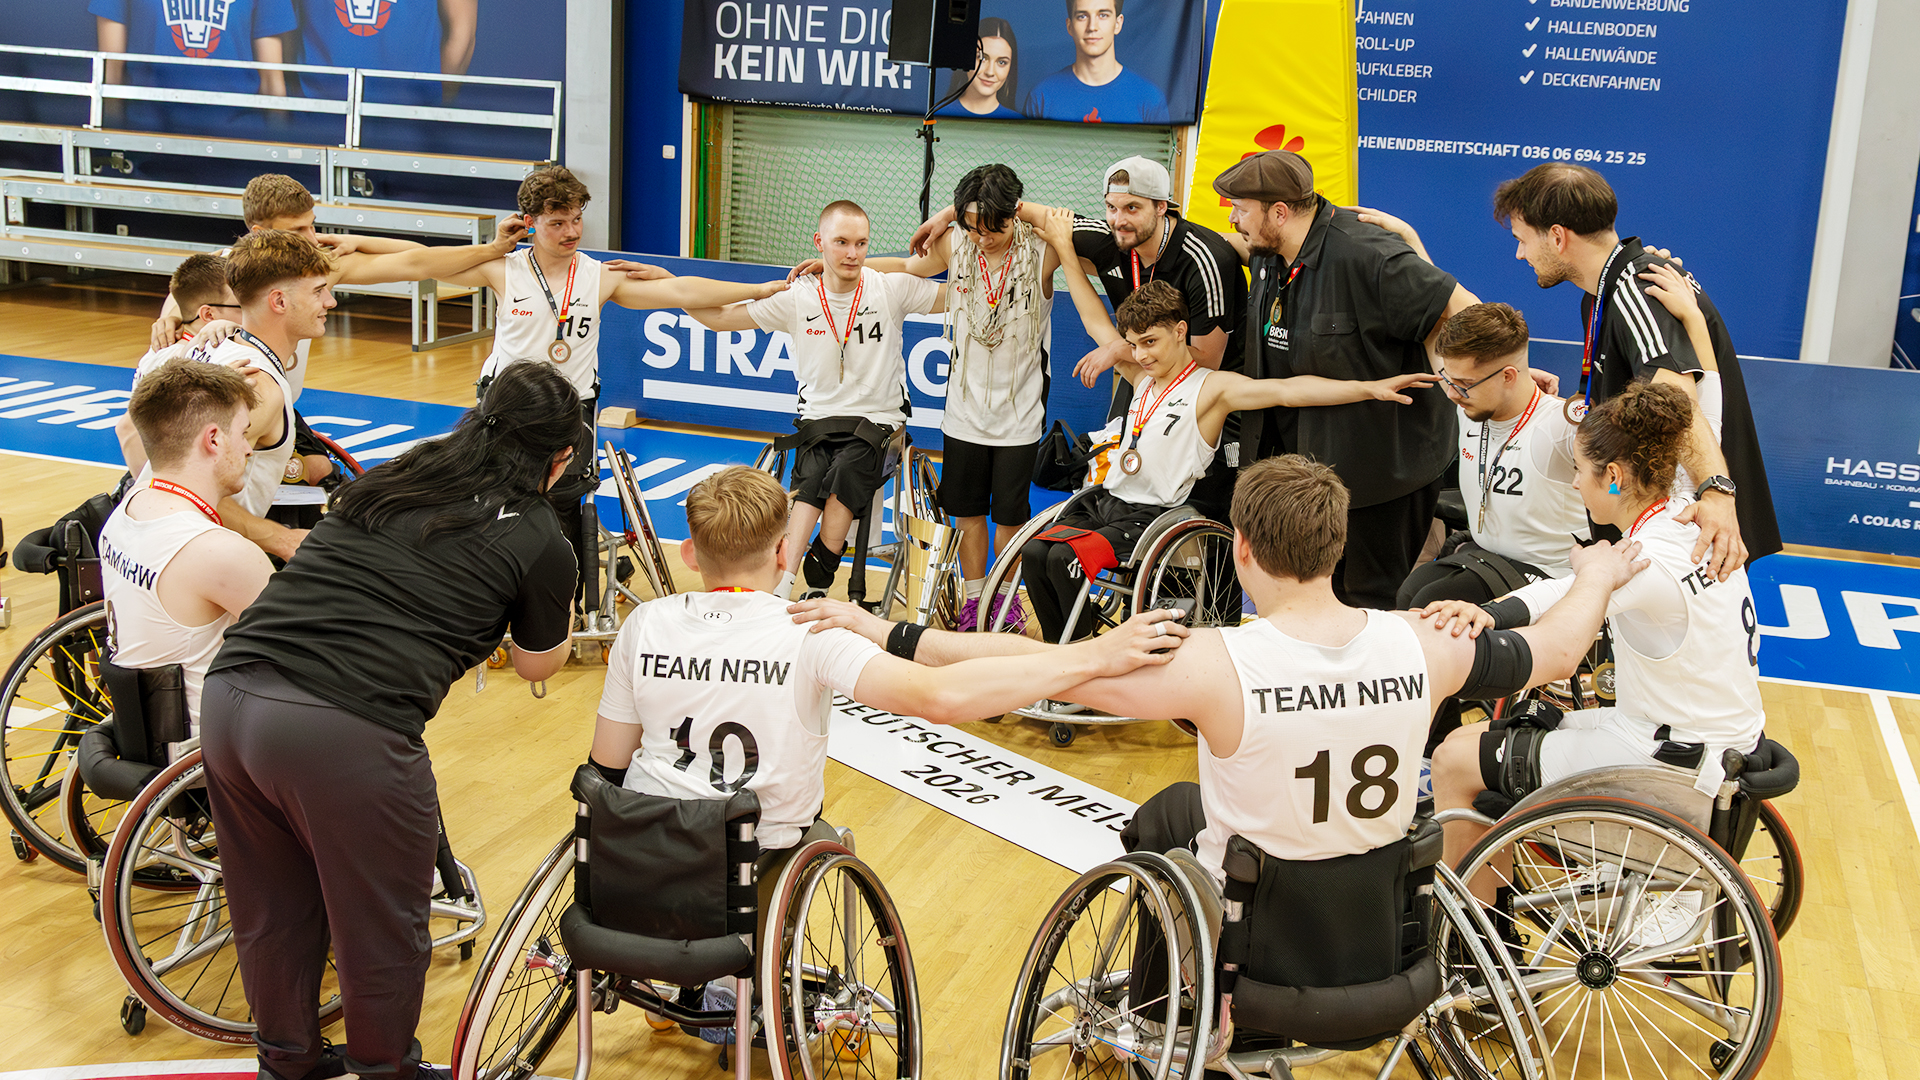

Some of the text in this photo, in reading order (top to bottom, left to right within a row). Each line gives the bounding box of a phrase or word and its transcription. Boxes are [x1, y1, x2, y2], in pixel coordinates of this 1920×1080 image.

[167, 0, 226, 25] BULLS
[1550, 0, 1690, 13] BANDENWERBUNG
[715, 1, 829, 43] OHNE
[1547, 20, 1658, 38] HALLENBODEN
[1355, 36, 1415, 52] ROLL-UP
[1545, 46, 1658, 65] HALLENWÄNDE
[714, 43, 912, 89] KEIN WIR!
[1542, 72, 1661, 91] DECKENFAHNEN
[1521, 145, 1550, 160] 036
[1552, 147, 1572, 161] 06
[1574, 148, 1602, 163] 694
[1605, 150, 1625, 165] 25
[1627, 152, 1647, 166] 25
[565, 315, 592, 339] 15
[853, 321, 883, 344] 14
[642, 311, 950, 398] STRAG
[1163, 413, 1181, 436] 7
[1492, 465, 1523, 496] 22
[1824, 478, 1877, 489] BAHNBAU
[1849, 514, 1859, 524] A
[1862, 515, 1912, 529] COLAS
[120, 554, 157, 591] NRW
[640, 653, 791, 685] TEAM NRW
[1251, 673, 1424, 714] TEAM NRW
[832, 694, 1036, 787] DEUTSCHER
[669, 716, 760, 793] 10
[900, 763, 1000, 806] 2026
[1294, 744, 1399, 824] 18
